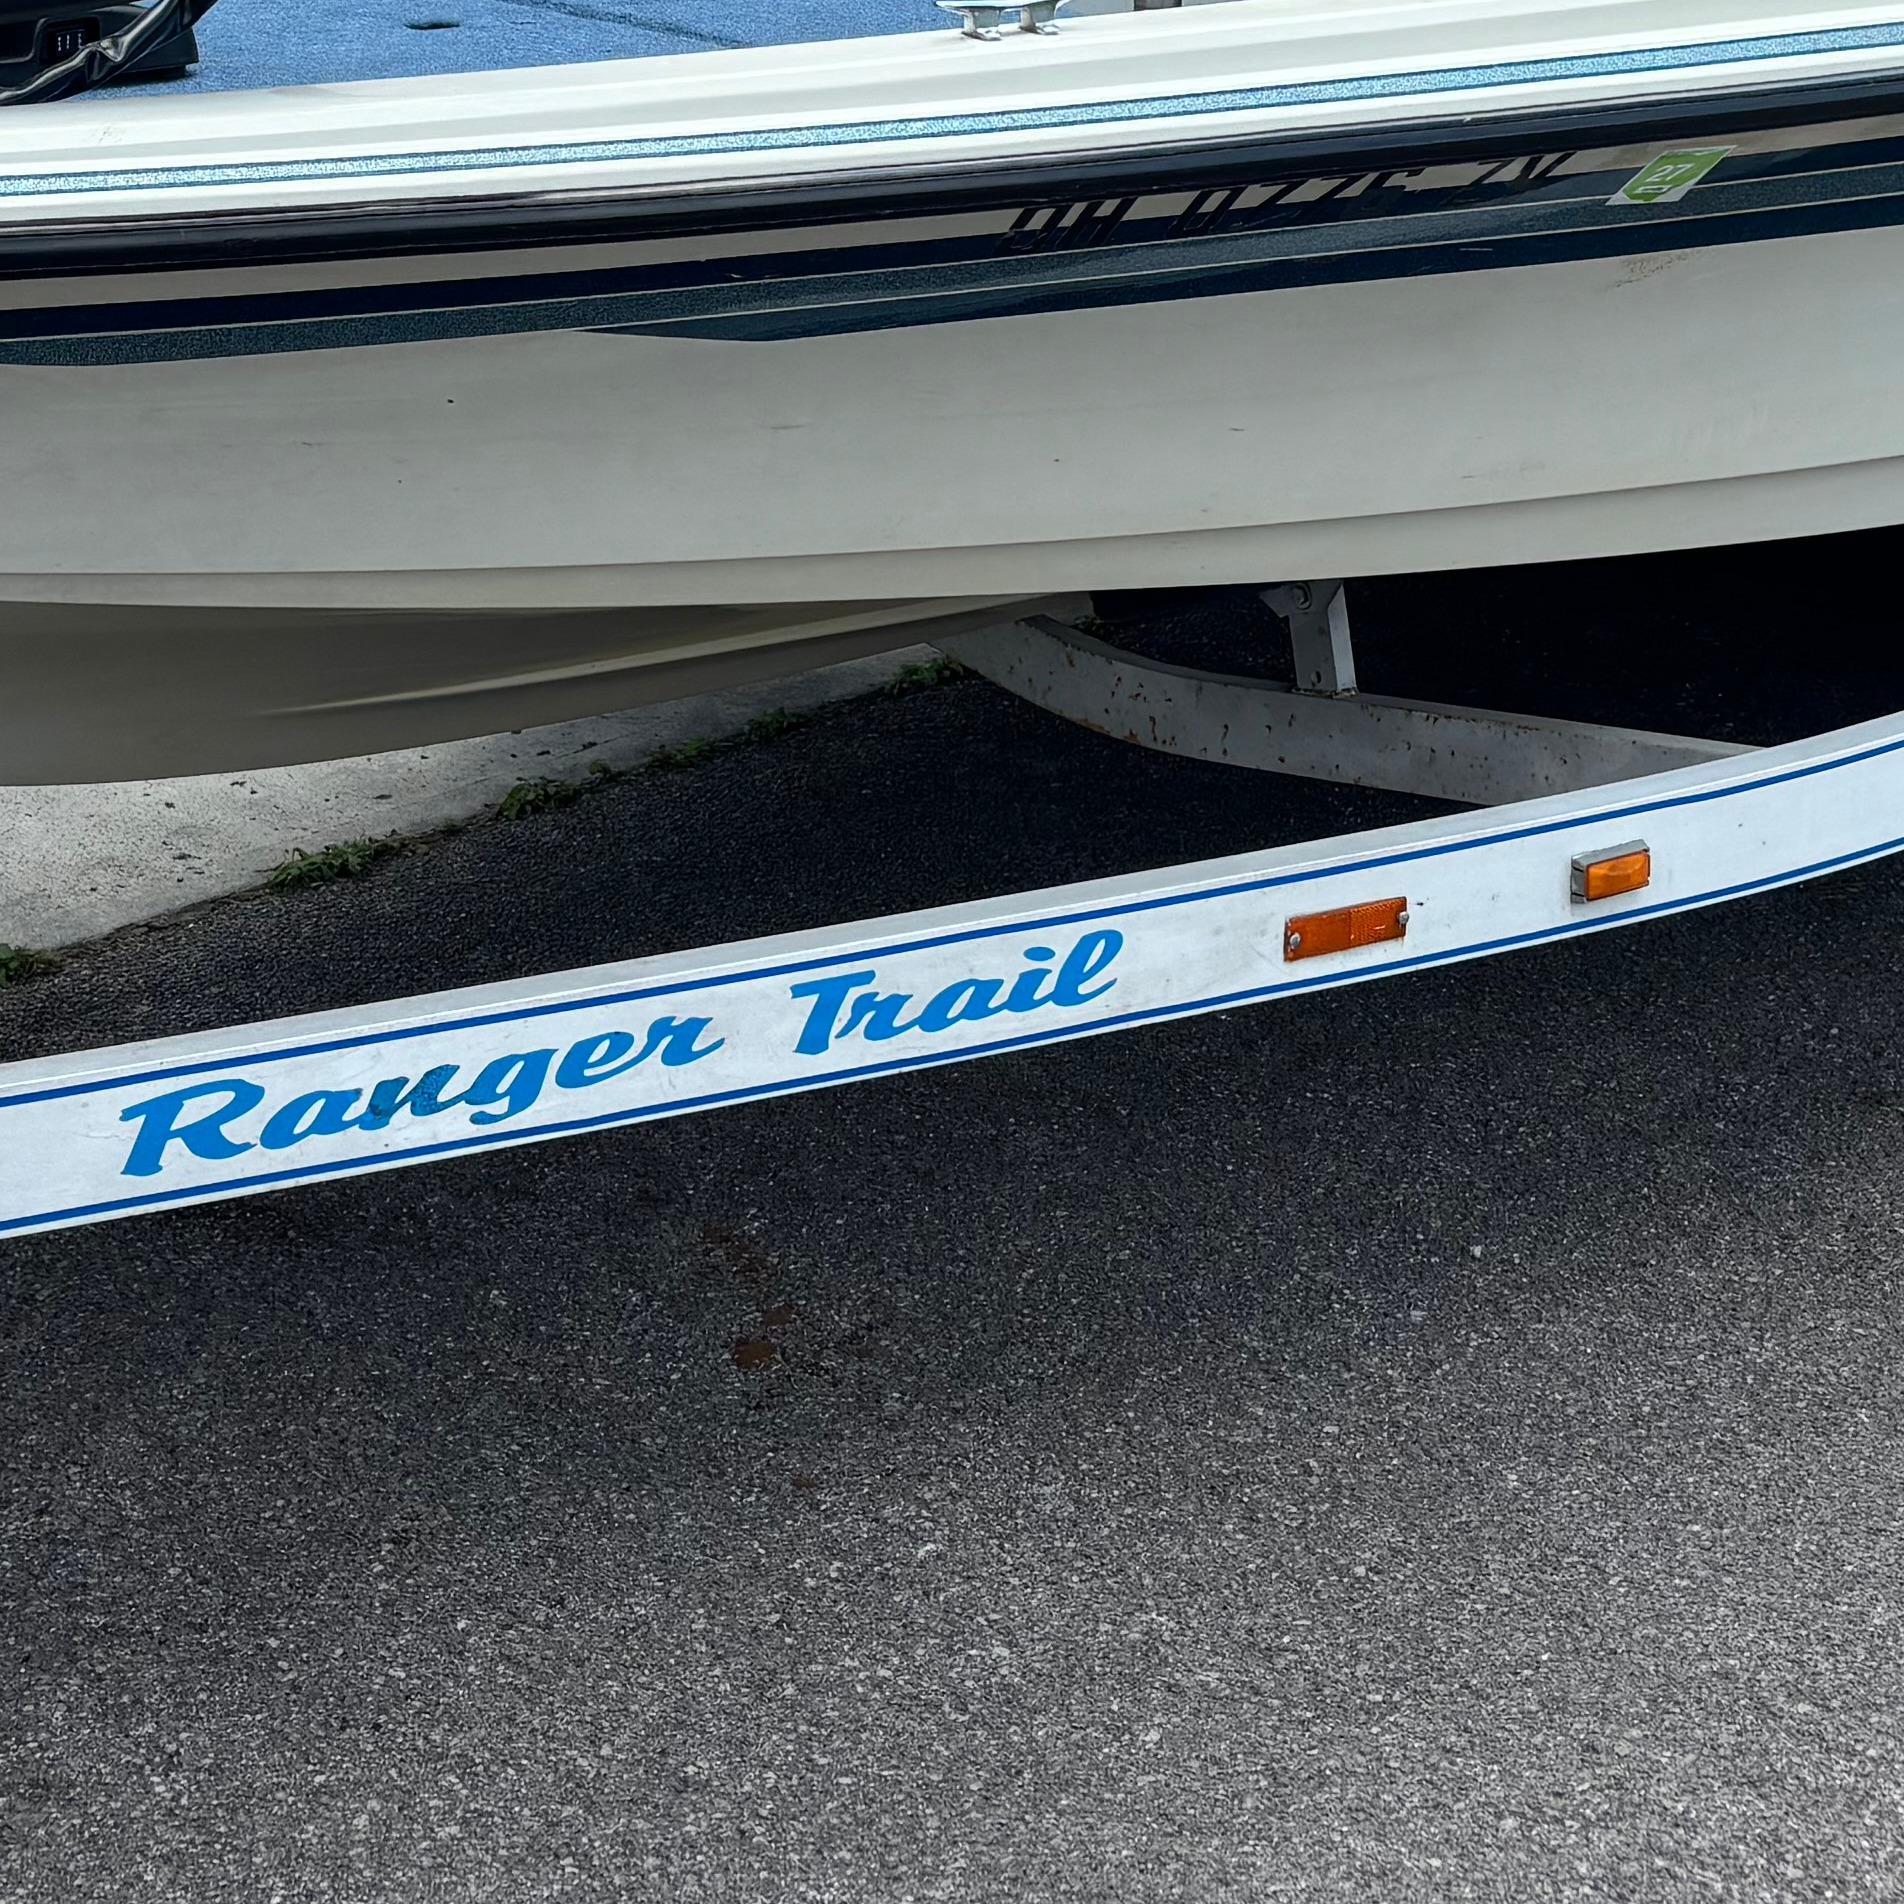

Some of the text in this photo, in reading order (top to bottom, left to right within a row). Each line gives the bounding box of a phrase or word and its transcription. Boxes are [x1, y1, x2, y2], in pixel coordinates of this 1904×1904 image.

[1651, 163, 1694, 182] 27
[119, 928, 1123, 1177] Ranger Trail
